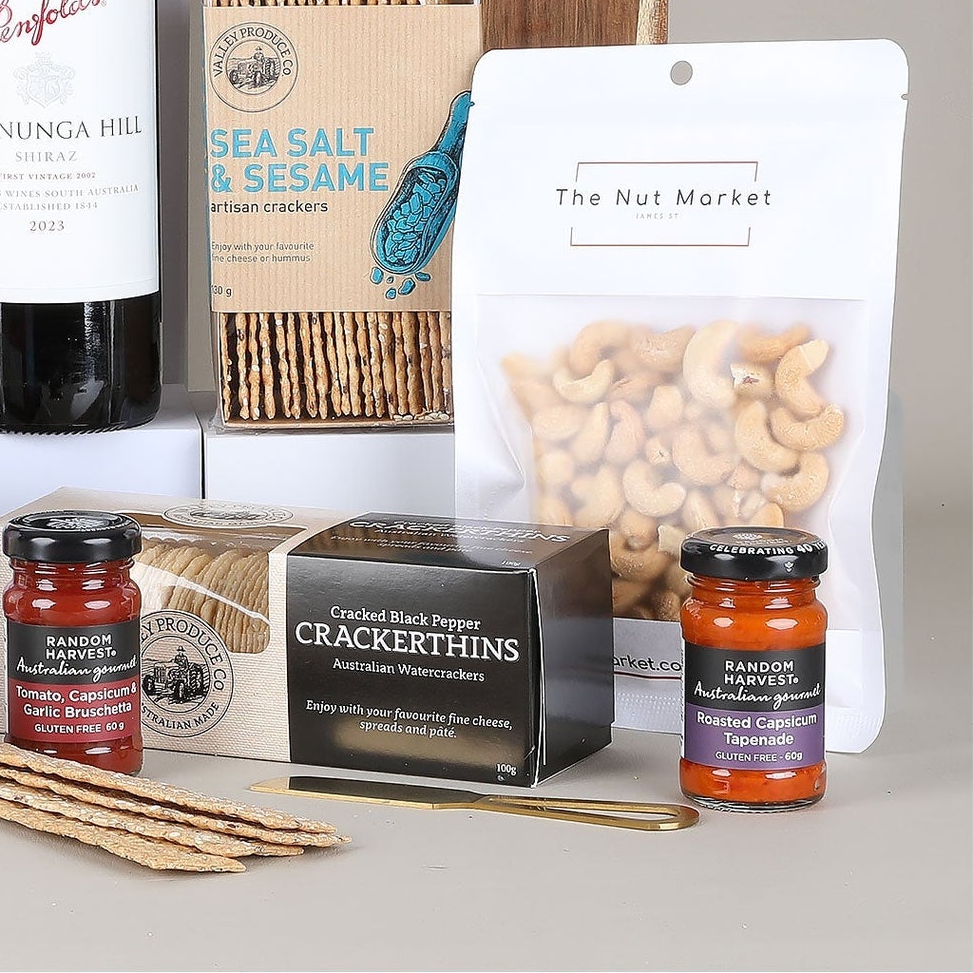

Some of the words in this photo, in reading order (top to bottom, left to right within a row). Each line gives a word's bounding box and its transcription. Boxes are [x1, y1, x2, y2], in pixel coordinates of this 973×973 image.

[213, 31, 238, 77] VALLEY
[240, 27, 291, 58] PRODUCE
[100, 115, 142, 137] HILL
[210, 128, 277, 158] SEA
[287, 127, 374, 157] SALT
[15, 150, 78, 163] SHIRAZ
[211, 164, 233, 193] &
[244, 163, 389, 192] SESAME
[5, 189, 41, 198] WINES
[45, 189, 83, 198] SOUTH
[87, 184, 139, 196] AUSTRALIA
[556, 189, 601, 206] The
[616, 189, 661, 206] Nut
[676, 189, 771, 206] Market
[211, 200, 259, 213] artisan
[263, 200, 328, 213] crackers
[29, 220, 65, 232] 2023
[212, 241, 232, 252] Enjoy
[233, 242, 252, 251] with
[254, 243, 273, 253] your
[276, 242, 314, 251] favourite
[272, 254, 311, 262] hummus
[211, 285, 223, 295] 30
[709, 544, 795, 555] CELEBRATING
[796, 543, 813, 553] 40
[330, 605, 387, 623] Cracked
[390, 610, 429, 627] Black
[432, 614, 481, 632] Pepper
[46, 634, 112, 647] RANDOM
[155, 617, 223, 665] PRODUCE
[295, 621, 520, 662] CRACKERTHINS
[16, 657, 92, 676] Australian
[92, 654, 137, 682] gourmet
[332, 658, 395, 675] Australian
[398, 663, 485, 682] Watercrackers
[725, 660, 794, 673] RANDOM
[16, 686, 65, 703] Tomato,
[68, 686, 129, 703] Capsicum
[131, 682, 137, 693] &
[694, 680, 772, 702] Australian
[773, 683, 822, 710] gourmet
[23, 705, 61, 718] Garlic
[65, 702, 132, 718] Bruschetta
[141, 703, 191, 729] STRALIAN
[194, 702, 219, 727] MADE
[306, 700, 337, 715] Enjoy
[339, 703, 364, 716] with
[367, 708, 393, 720] your
[394, 708, 446, 724] favourite
[446, 713, 470, 726] fine
[472, 715, 513, 730] cheese,
[34, 724, 74, 733] GLUTEN
[76, 724, 102, 733] FREE
[359, 719, 403, 733] spreads
[405, 723, 426, 735] and
[428, 724, 457, 739] pâté.
[697, 711, 751, 728] Roasted
[755, 714, 817, 731] Capsicum
[724, 732, 794, 747] Tapenade
[715, 751, 752, 762] GLUTEN
[753, 753, 778, 762] FREE
[784, 751, 803, 761] 60g
[496, 763, 517, 776] 100g
